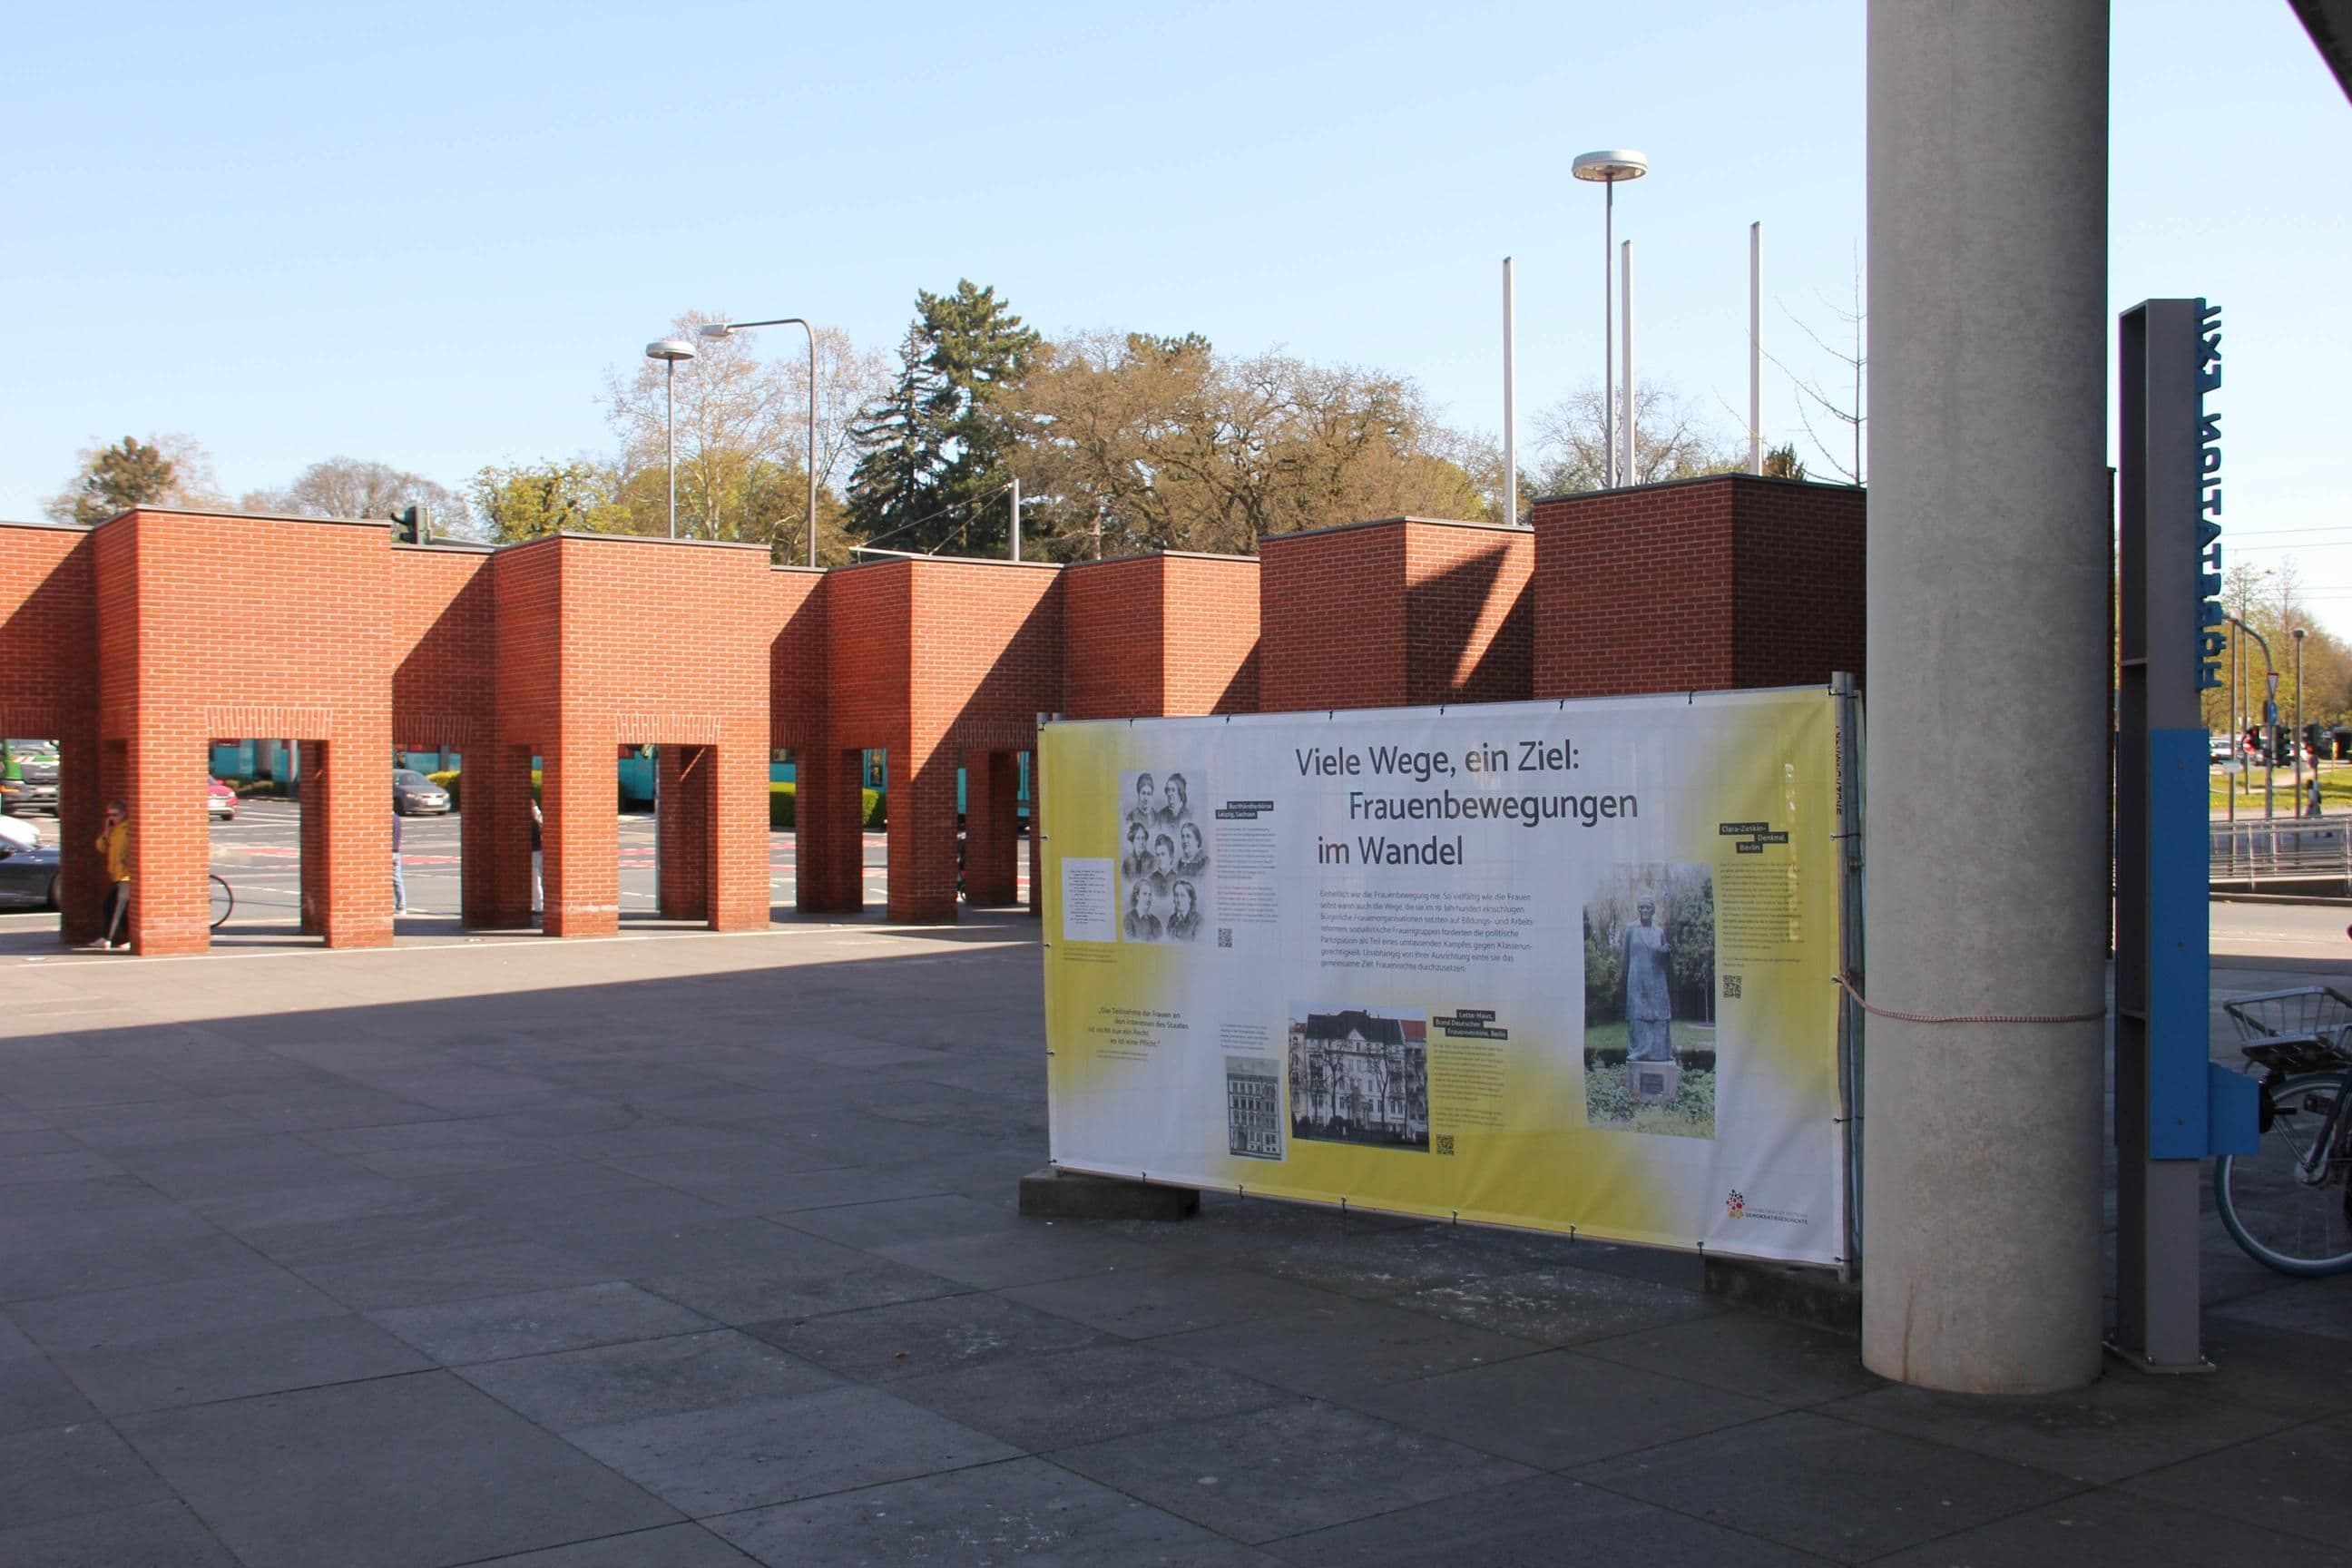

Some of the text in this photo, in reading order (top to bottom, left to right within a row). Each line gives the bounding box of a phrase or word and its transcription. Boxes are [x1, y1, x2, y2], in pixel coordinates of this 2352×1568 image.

[1296, 739, 1579, 782] Viele Wege, ein Ziel:
[1349, 789, 1638, 828] Frauenbewegungen
[1318, 835, 1463, 865] im Wandel
[1374, 890, 1428, 900] Frauenbewegung
[1507, 893, 1531, 901] Frauen
[1384, 903, 1404, 911] Wege,
[1393, 926, 1440, 936] Frauengruppen
[1442, 928, 1472, 936] forderten
[1485, 930, 1519, 938] politische
[1502, 954, 1514, 962] das
[1152, 1010, 1171, 1018] Frauen
[1167, 1022, 1189, 1030] Staates
[1451, 1019, 1481, 1027] Deutscher
